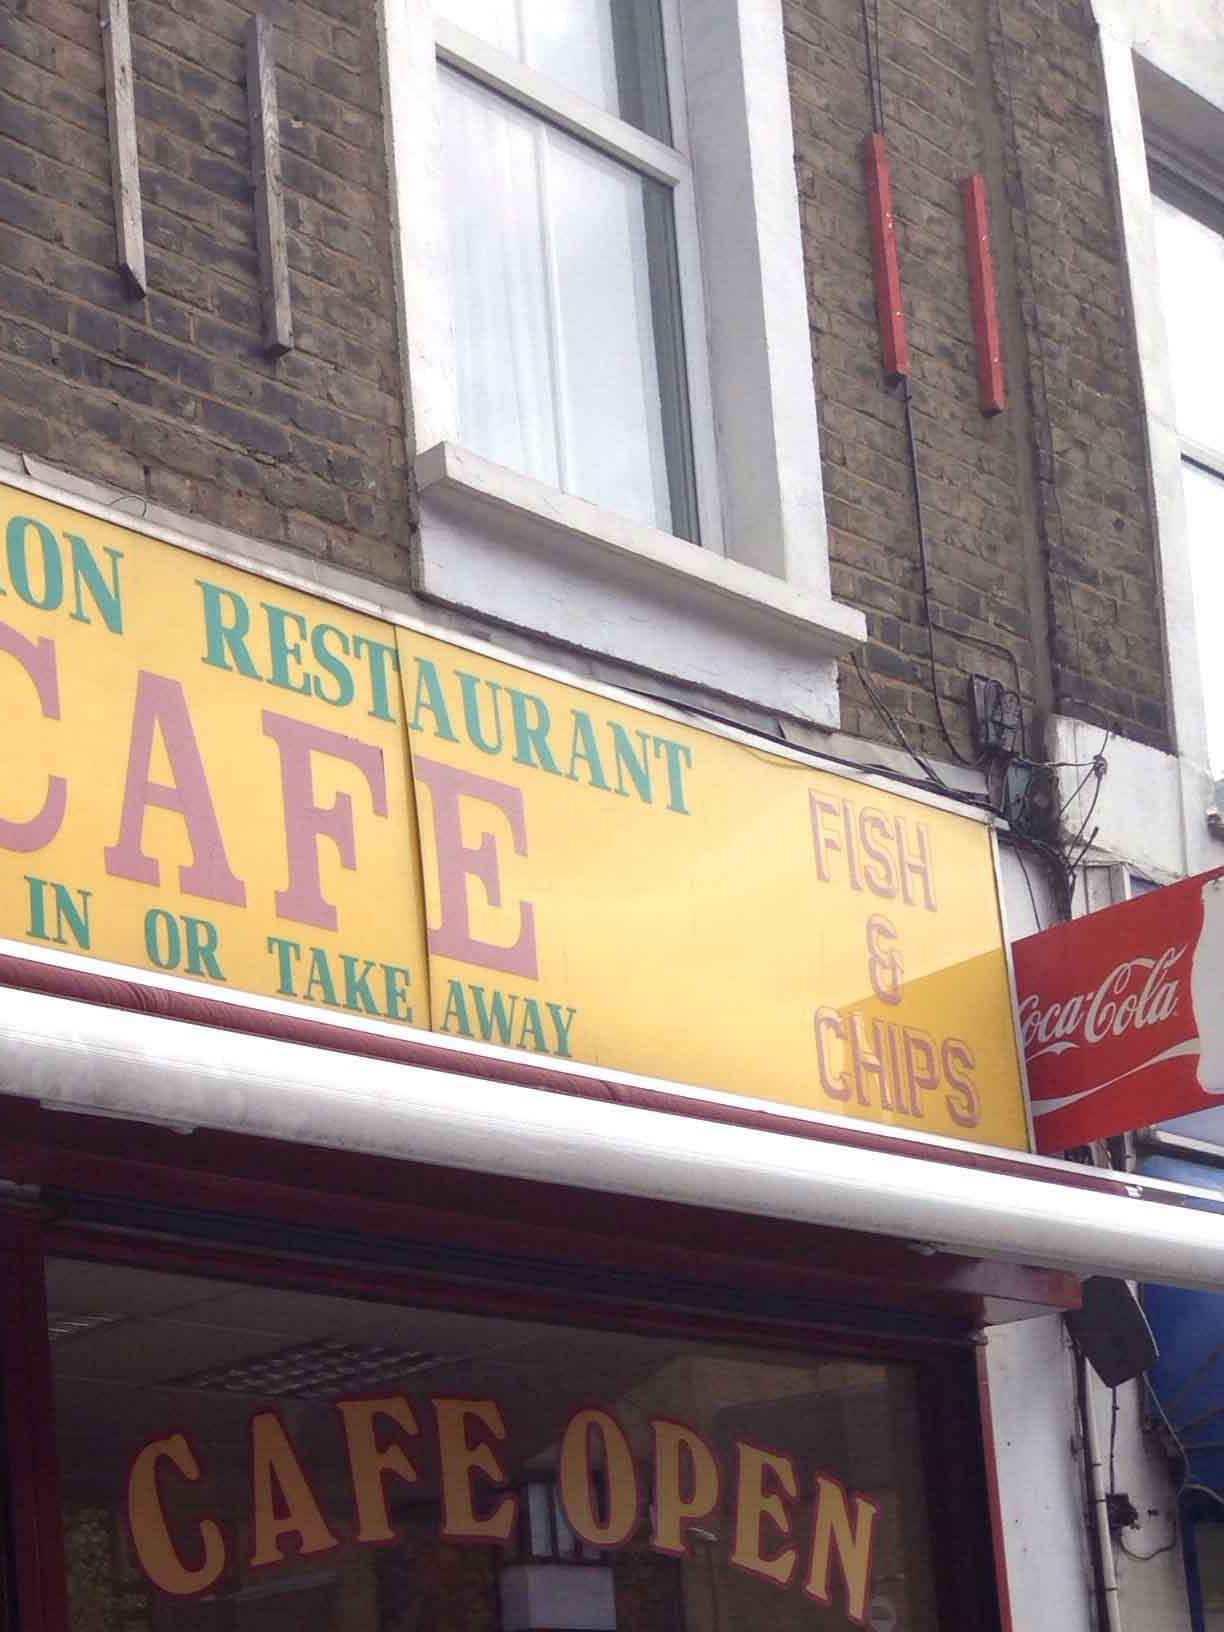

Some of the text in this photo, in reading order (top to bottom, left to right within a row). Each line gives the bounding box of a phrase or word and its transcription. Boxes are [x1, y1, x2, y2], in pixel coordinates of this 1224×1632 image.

[195, 578, 693, 816] RESTAURANT
[807, 787, 938, 913] FISH
[24, 874, 93, 951] IN
[144, 907, 227, 982] OR
[266, 935, 413, 1024] TAKE
[440, 978, 577, 1058] AWAY
[865, 913, 904, 1006] &
[813, 1006, 982, 1129] CHIPS
[126, 1394, 884, 1628] CAFE OPEN
